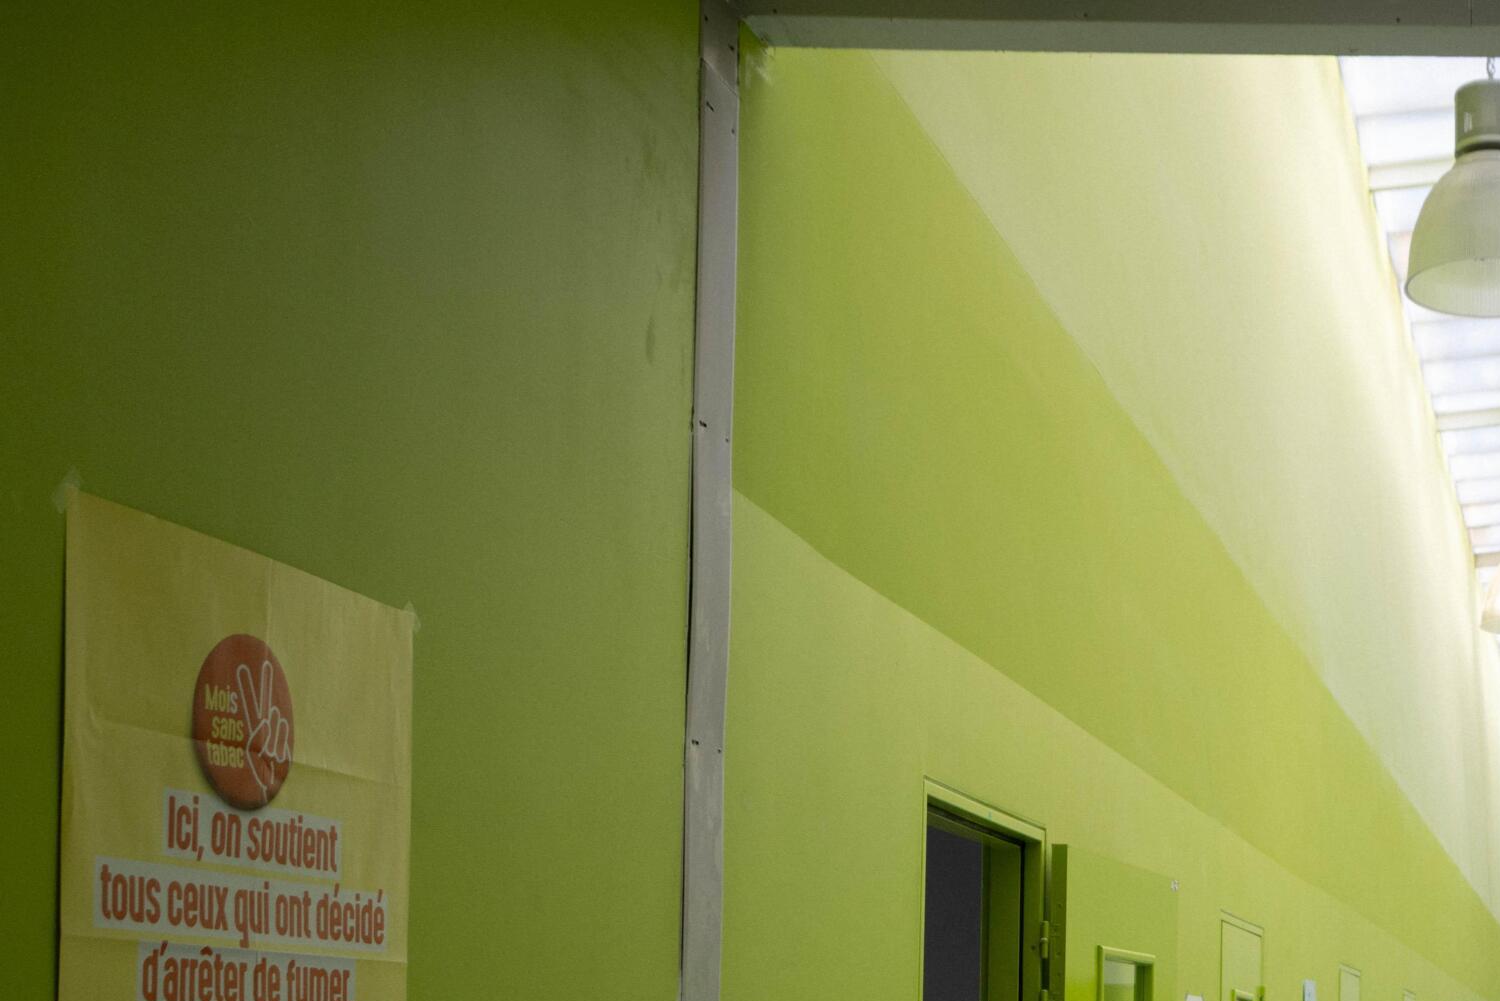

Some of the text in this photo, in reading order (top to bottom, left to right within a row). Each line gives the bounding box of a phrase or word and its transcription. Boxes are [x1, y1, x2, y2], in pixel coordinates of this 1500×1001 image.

[205, 684, 238, 714] Mois
[211, 716, 244, 742] sans
[206, 740, 244, 769] tabac
[167, 796, 338, 873] Ici, on soutient
[100, 863, 385, 949] tous ceux qui ont décidé
